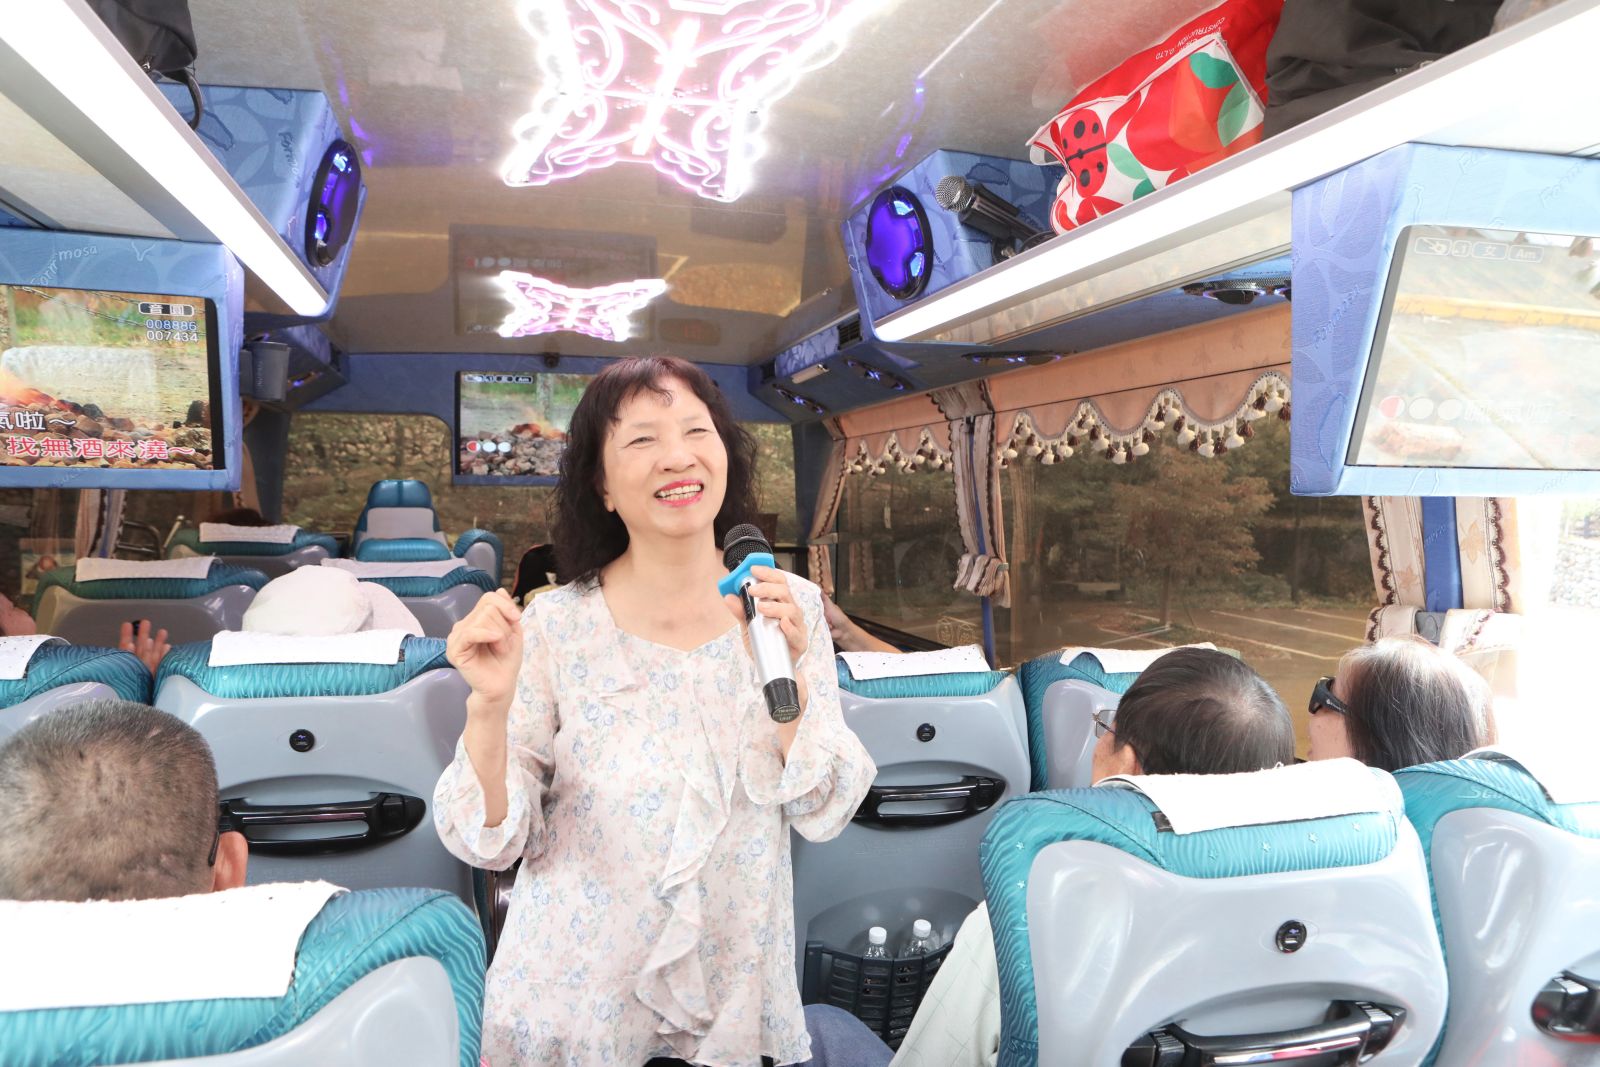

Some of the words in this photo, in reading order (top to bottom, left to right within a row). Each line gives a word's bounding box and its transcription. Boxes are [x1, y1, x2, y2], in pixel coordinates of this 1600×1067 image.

[1515, 248, 1536, 260] Am
[146, 319, 197, 331] 008886
[146, 330, 199, 343] 007434
